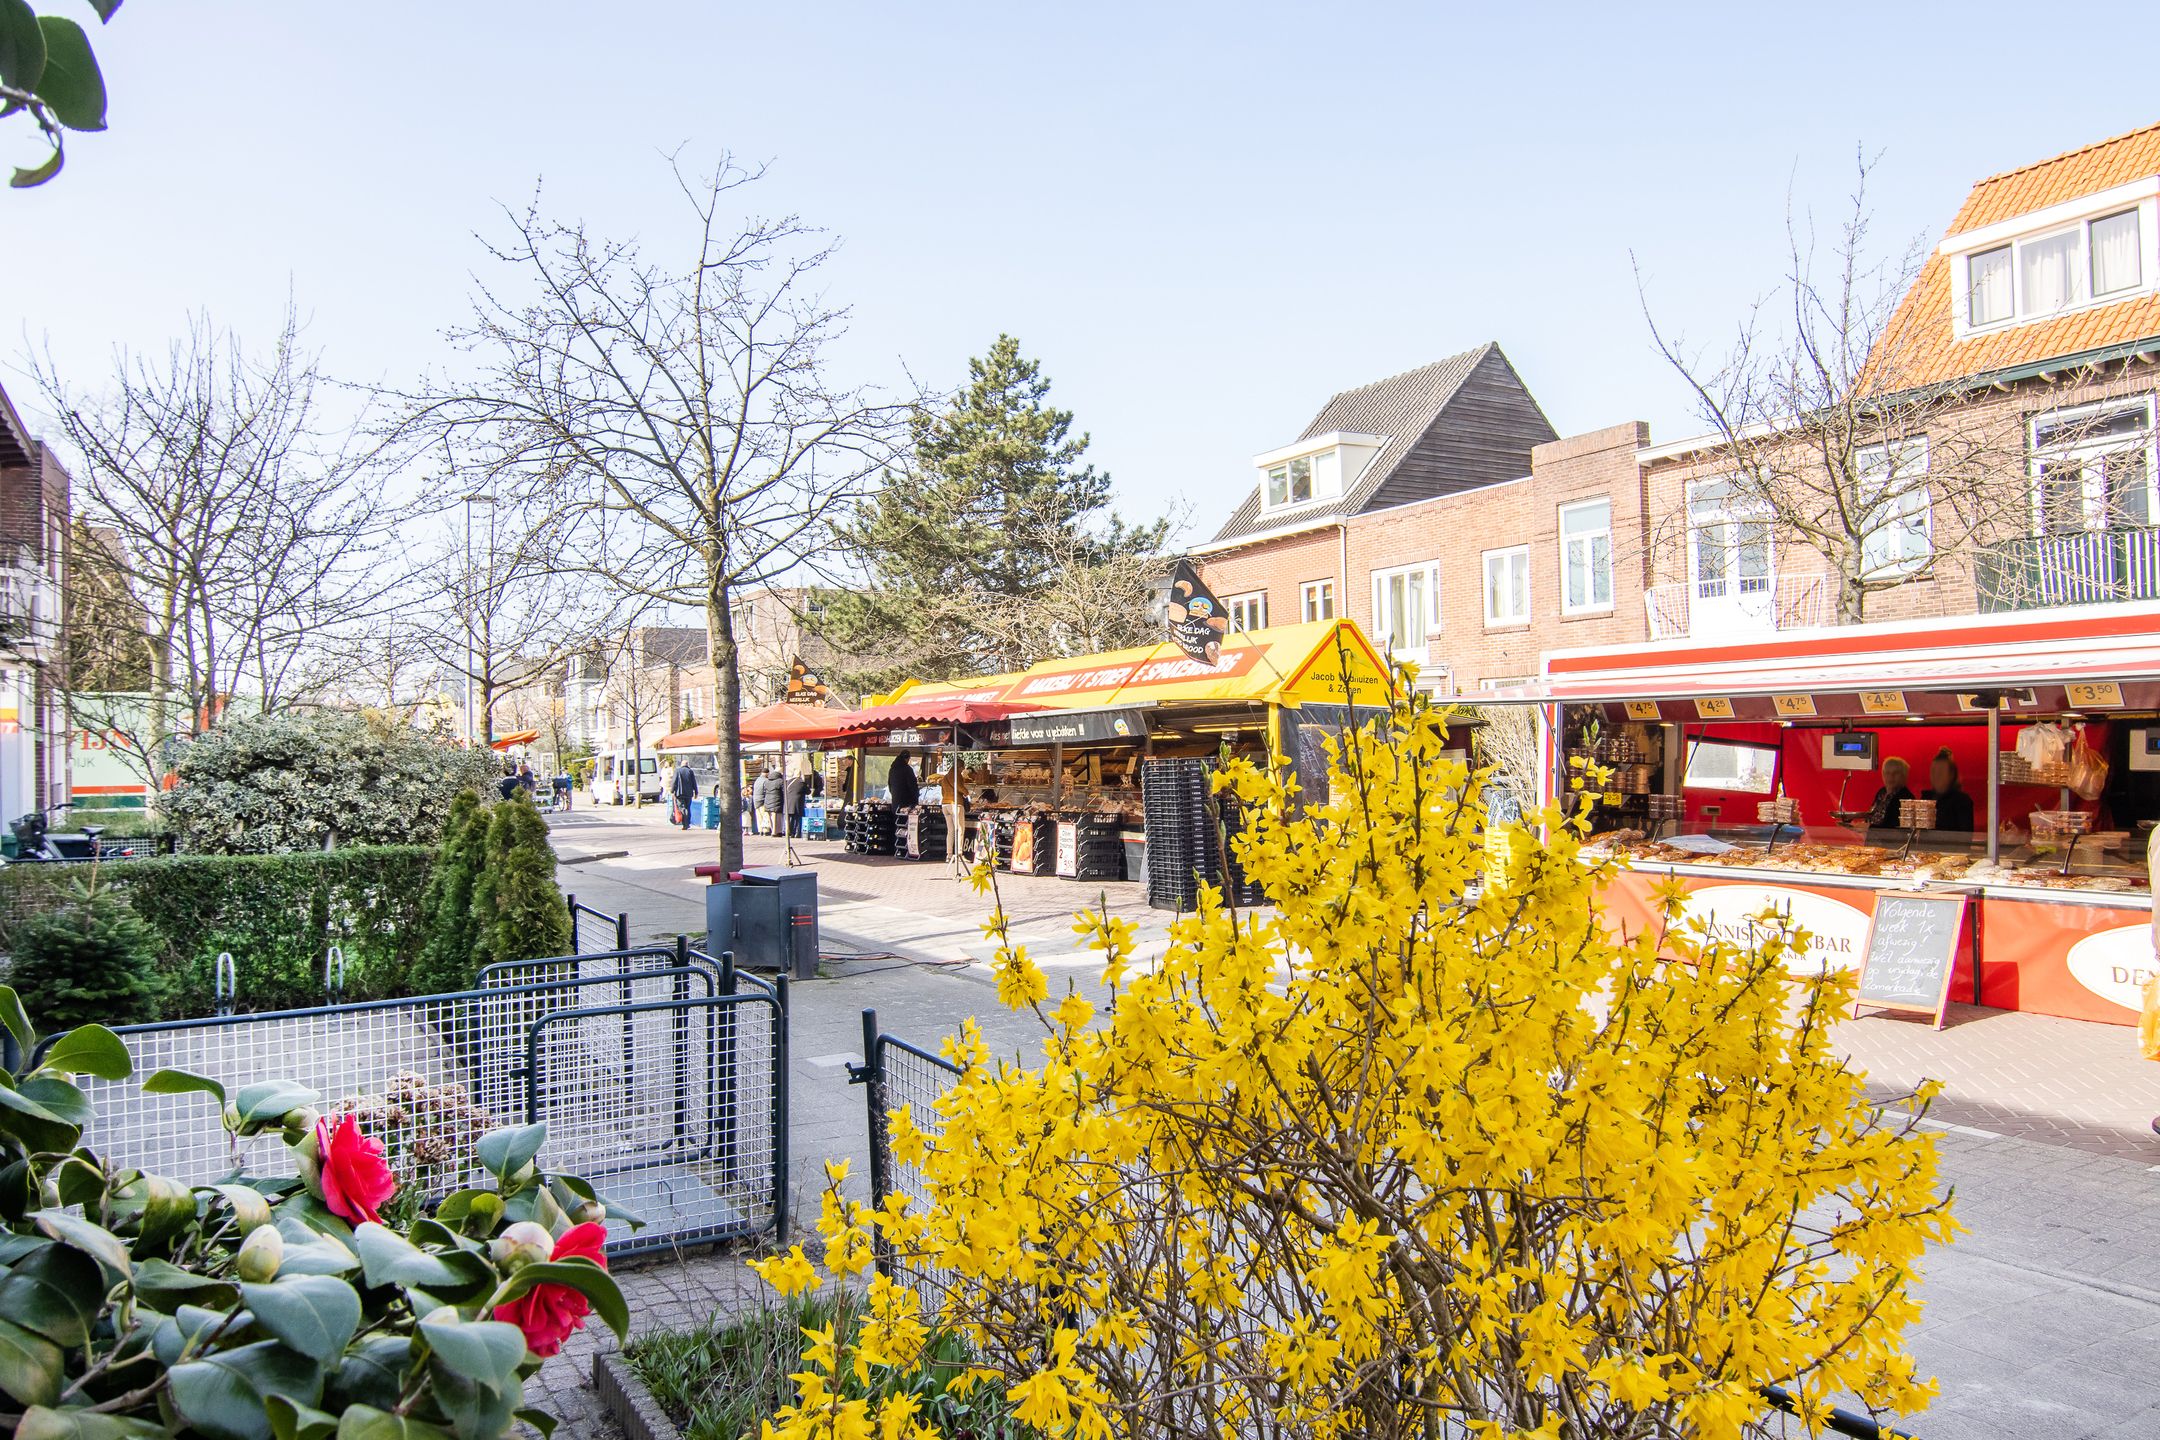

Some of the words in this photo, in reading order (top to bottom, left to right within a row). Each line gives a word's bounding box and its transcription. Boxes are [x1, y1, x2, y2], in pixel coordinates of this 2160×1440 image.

[1194, 627, 1211, 636] DAG
[1085, 664, 1151, 688] STOEPE
[1310, 672, 1335, 681] Jacob
[1328, 684, 1334, 693] &
[1338, 684, 1362, 694] Zonen
[1011, 728, 1030, 740] liefde
[1030, 730, 1044, 739] voor
[1059, 848, 1064, 859] 2
[1881, 899, 1936, 920] Volgende
[1878, 920, 1908, 933] week
[1702, 922, 1750, 941] NNIS
[1754, 928, 1852, 953] NOTNBAR
